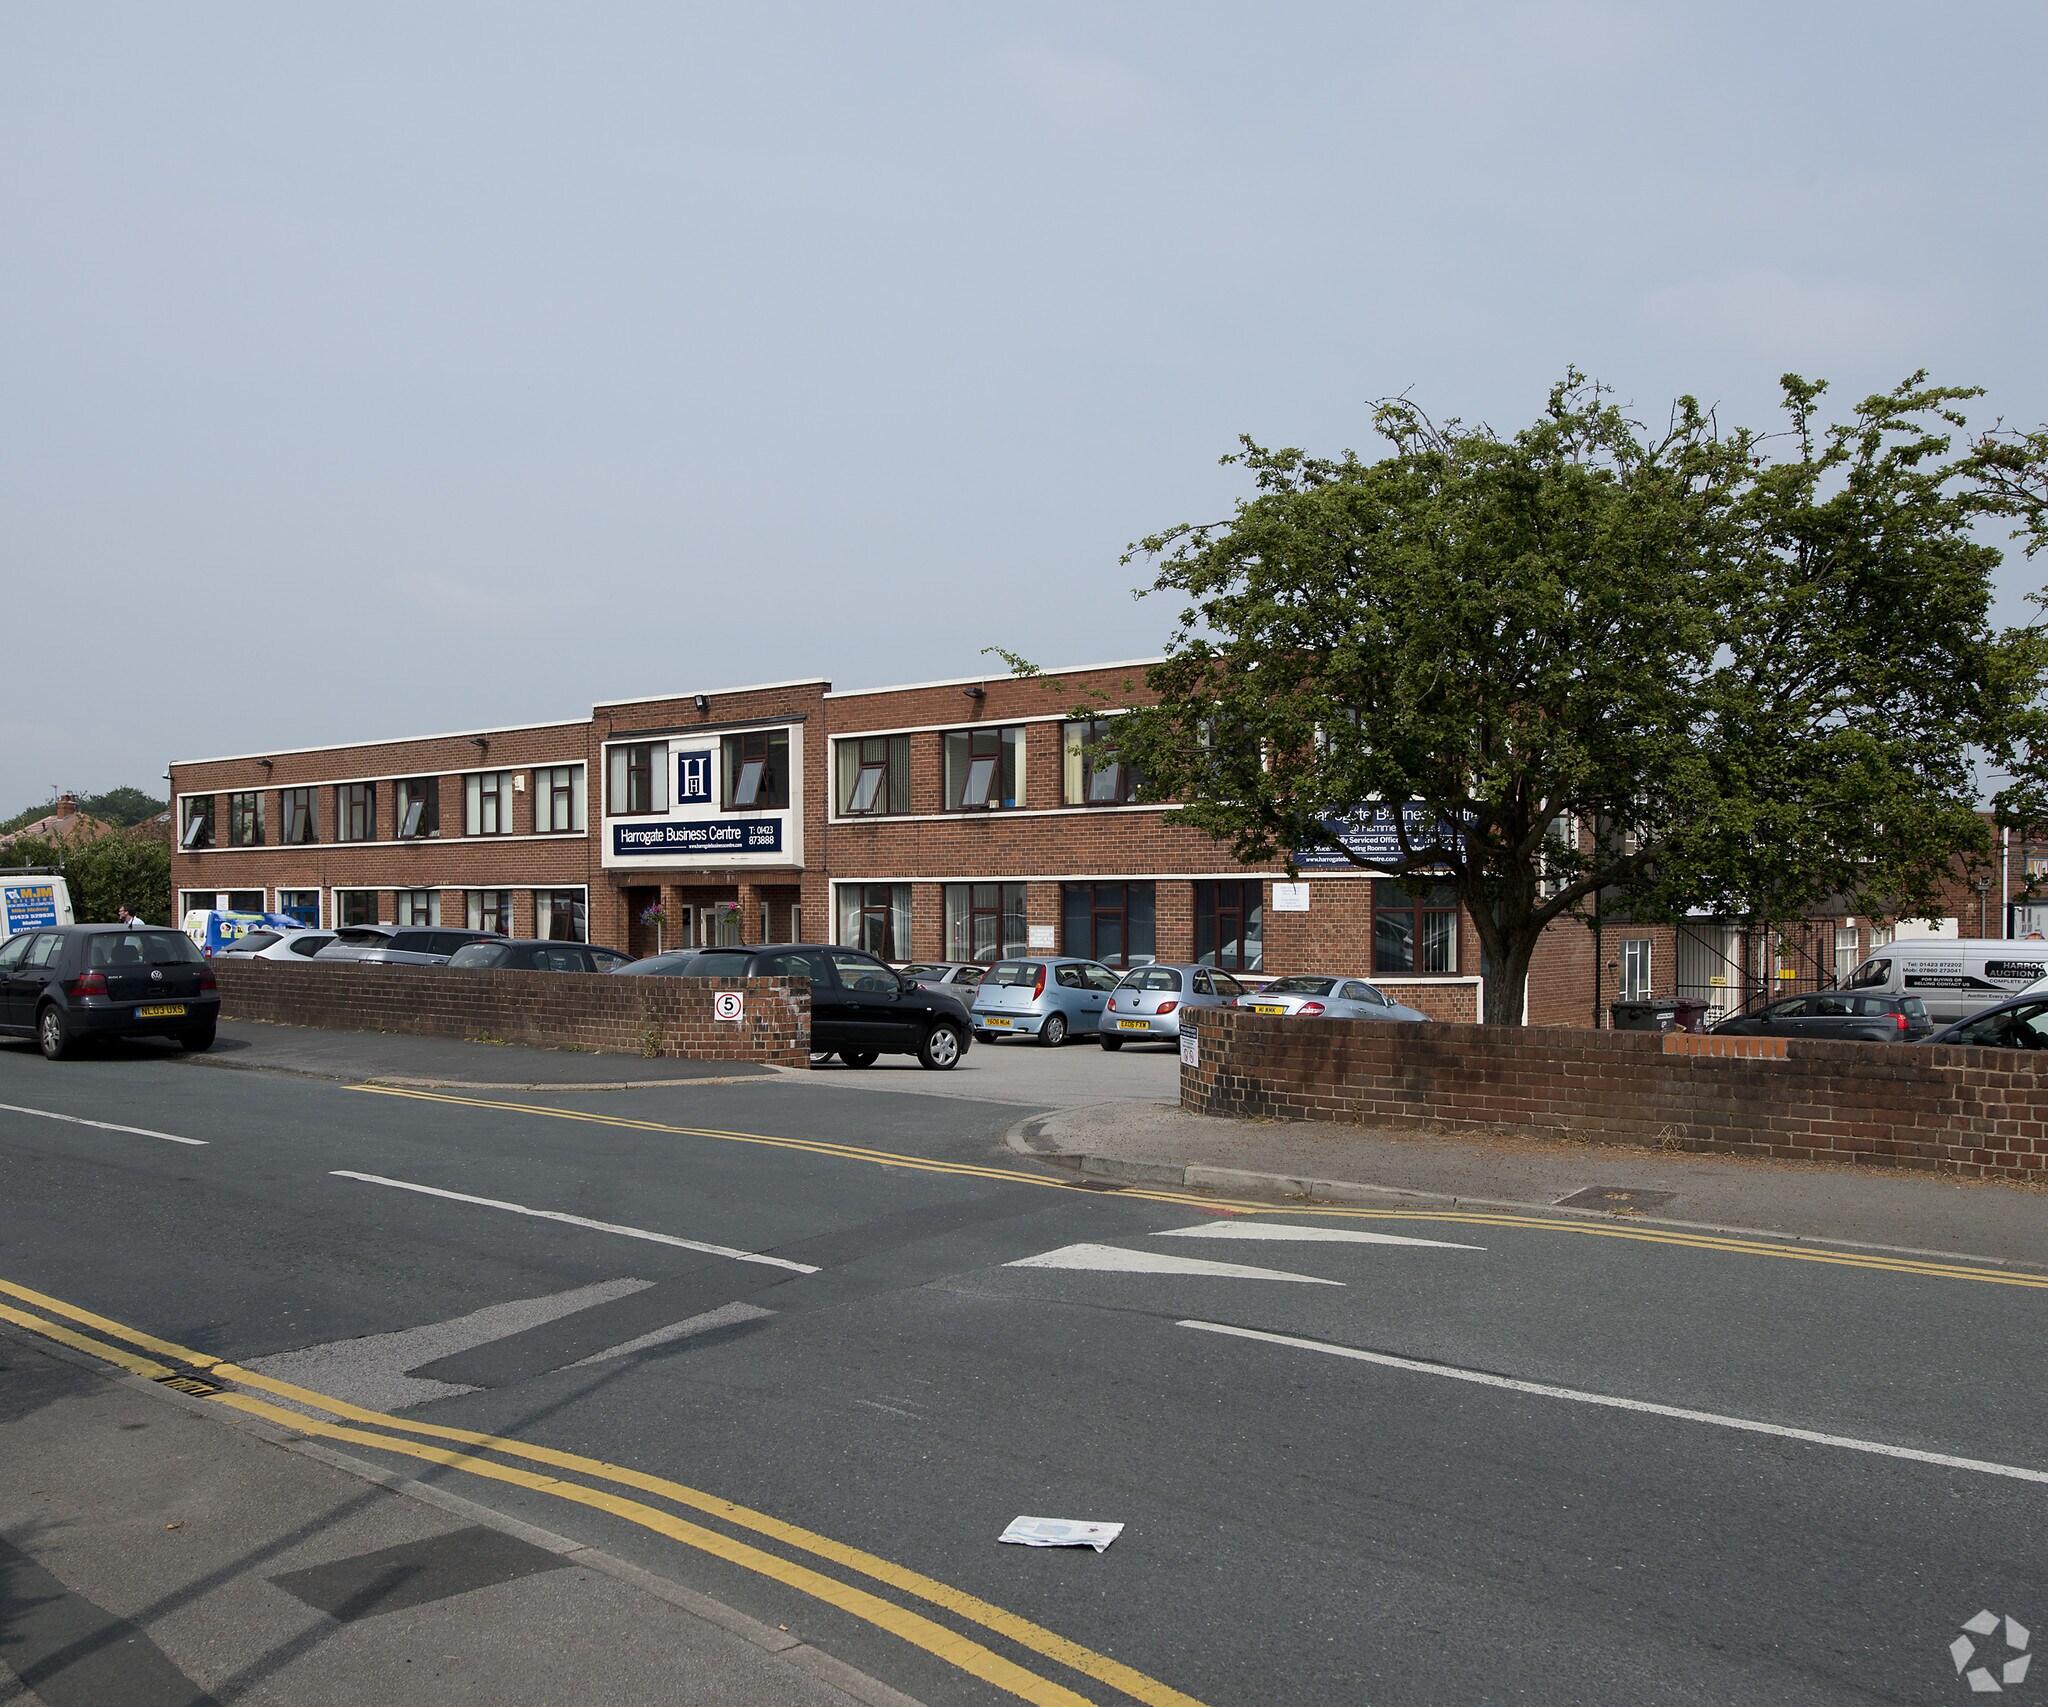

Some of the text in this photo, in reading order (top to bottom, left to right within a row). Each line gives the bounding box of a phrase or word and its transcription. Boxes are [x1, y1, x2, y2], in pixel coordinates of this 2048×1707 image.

[620, 826, 742, 845] Harrogate Business Centre
[756, 826, 774, 835] 01423
[748, 835, 775, 845] 873888
[1349, 836, 1379, 844] Serviced
[1367, 844, 1388, 852] Rooms
[20, 887, 53, 899] MJM
[723, 996, 734, 1011] 5
[140, 1004, 184, 1015] NL03 UXS
